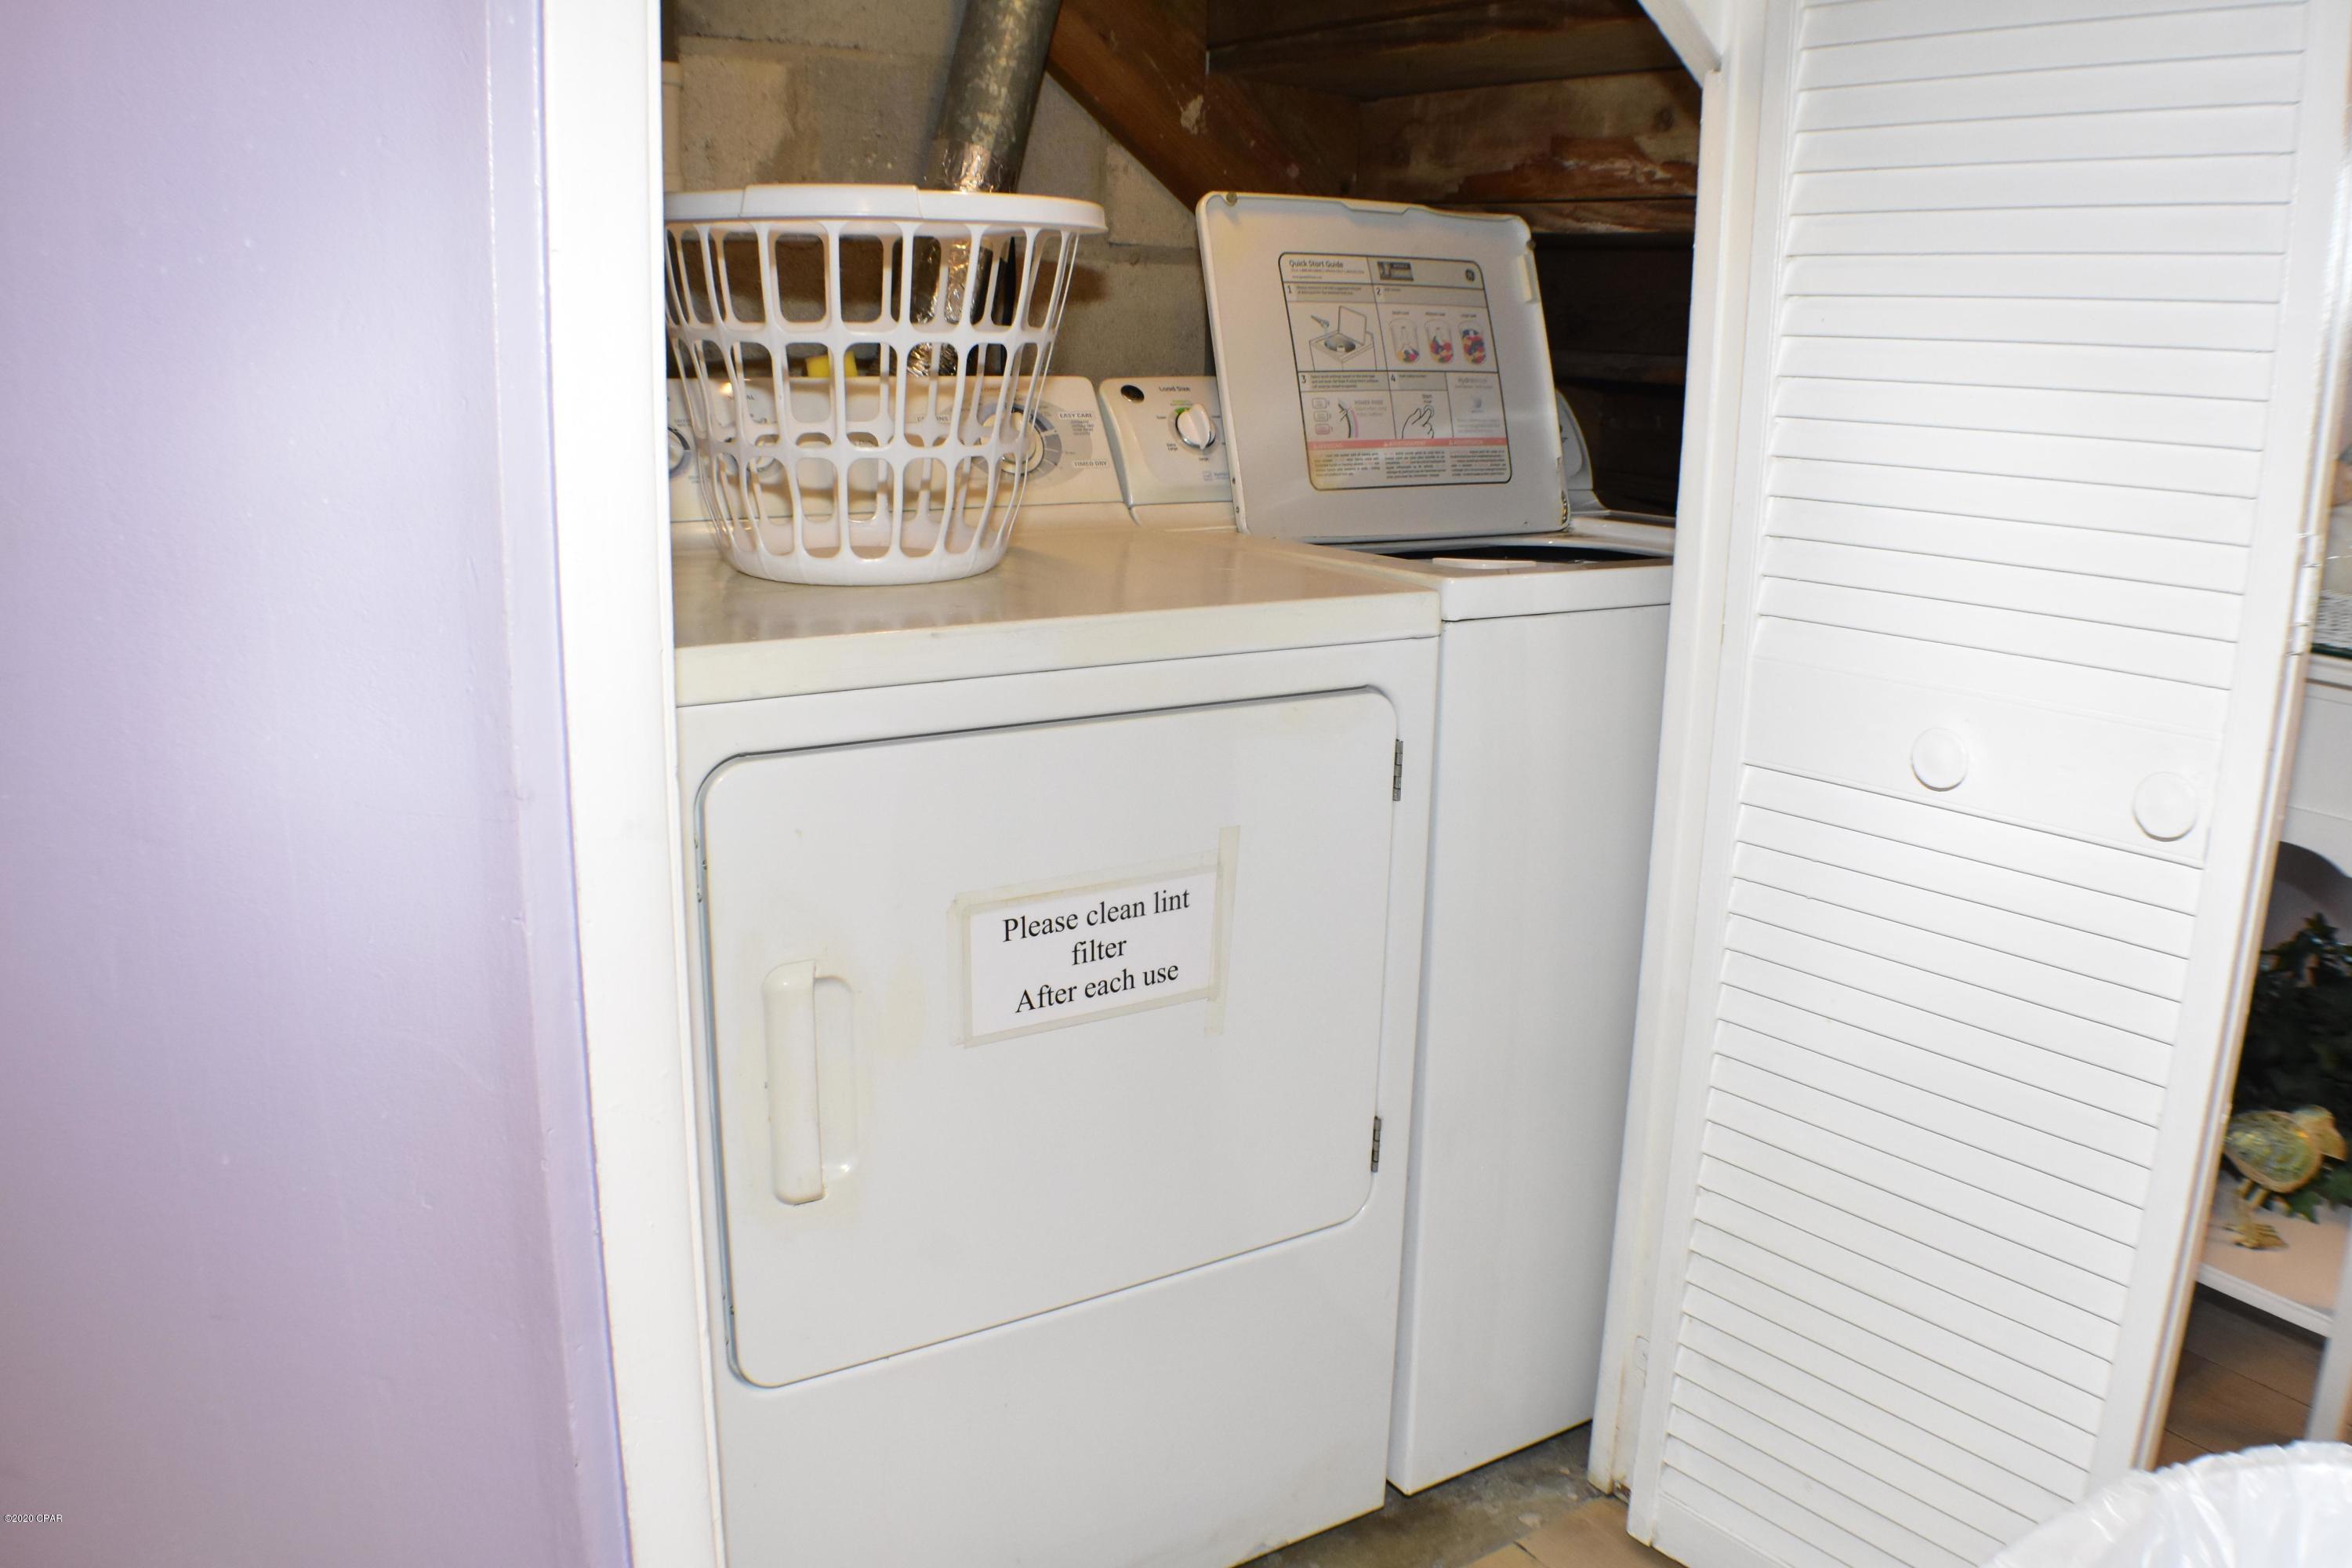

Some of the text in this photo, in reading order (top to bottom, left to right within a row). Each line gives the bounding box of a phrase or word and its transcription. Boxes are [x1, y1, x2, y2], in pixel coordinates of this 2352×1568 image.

[1003, 888, 1190, 942] Please clean lint
[1072, 938, 1127, 966] filter
[1015, 964, 1179, 1013] After each use
